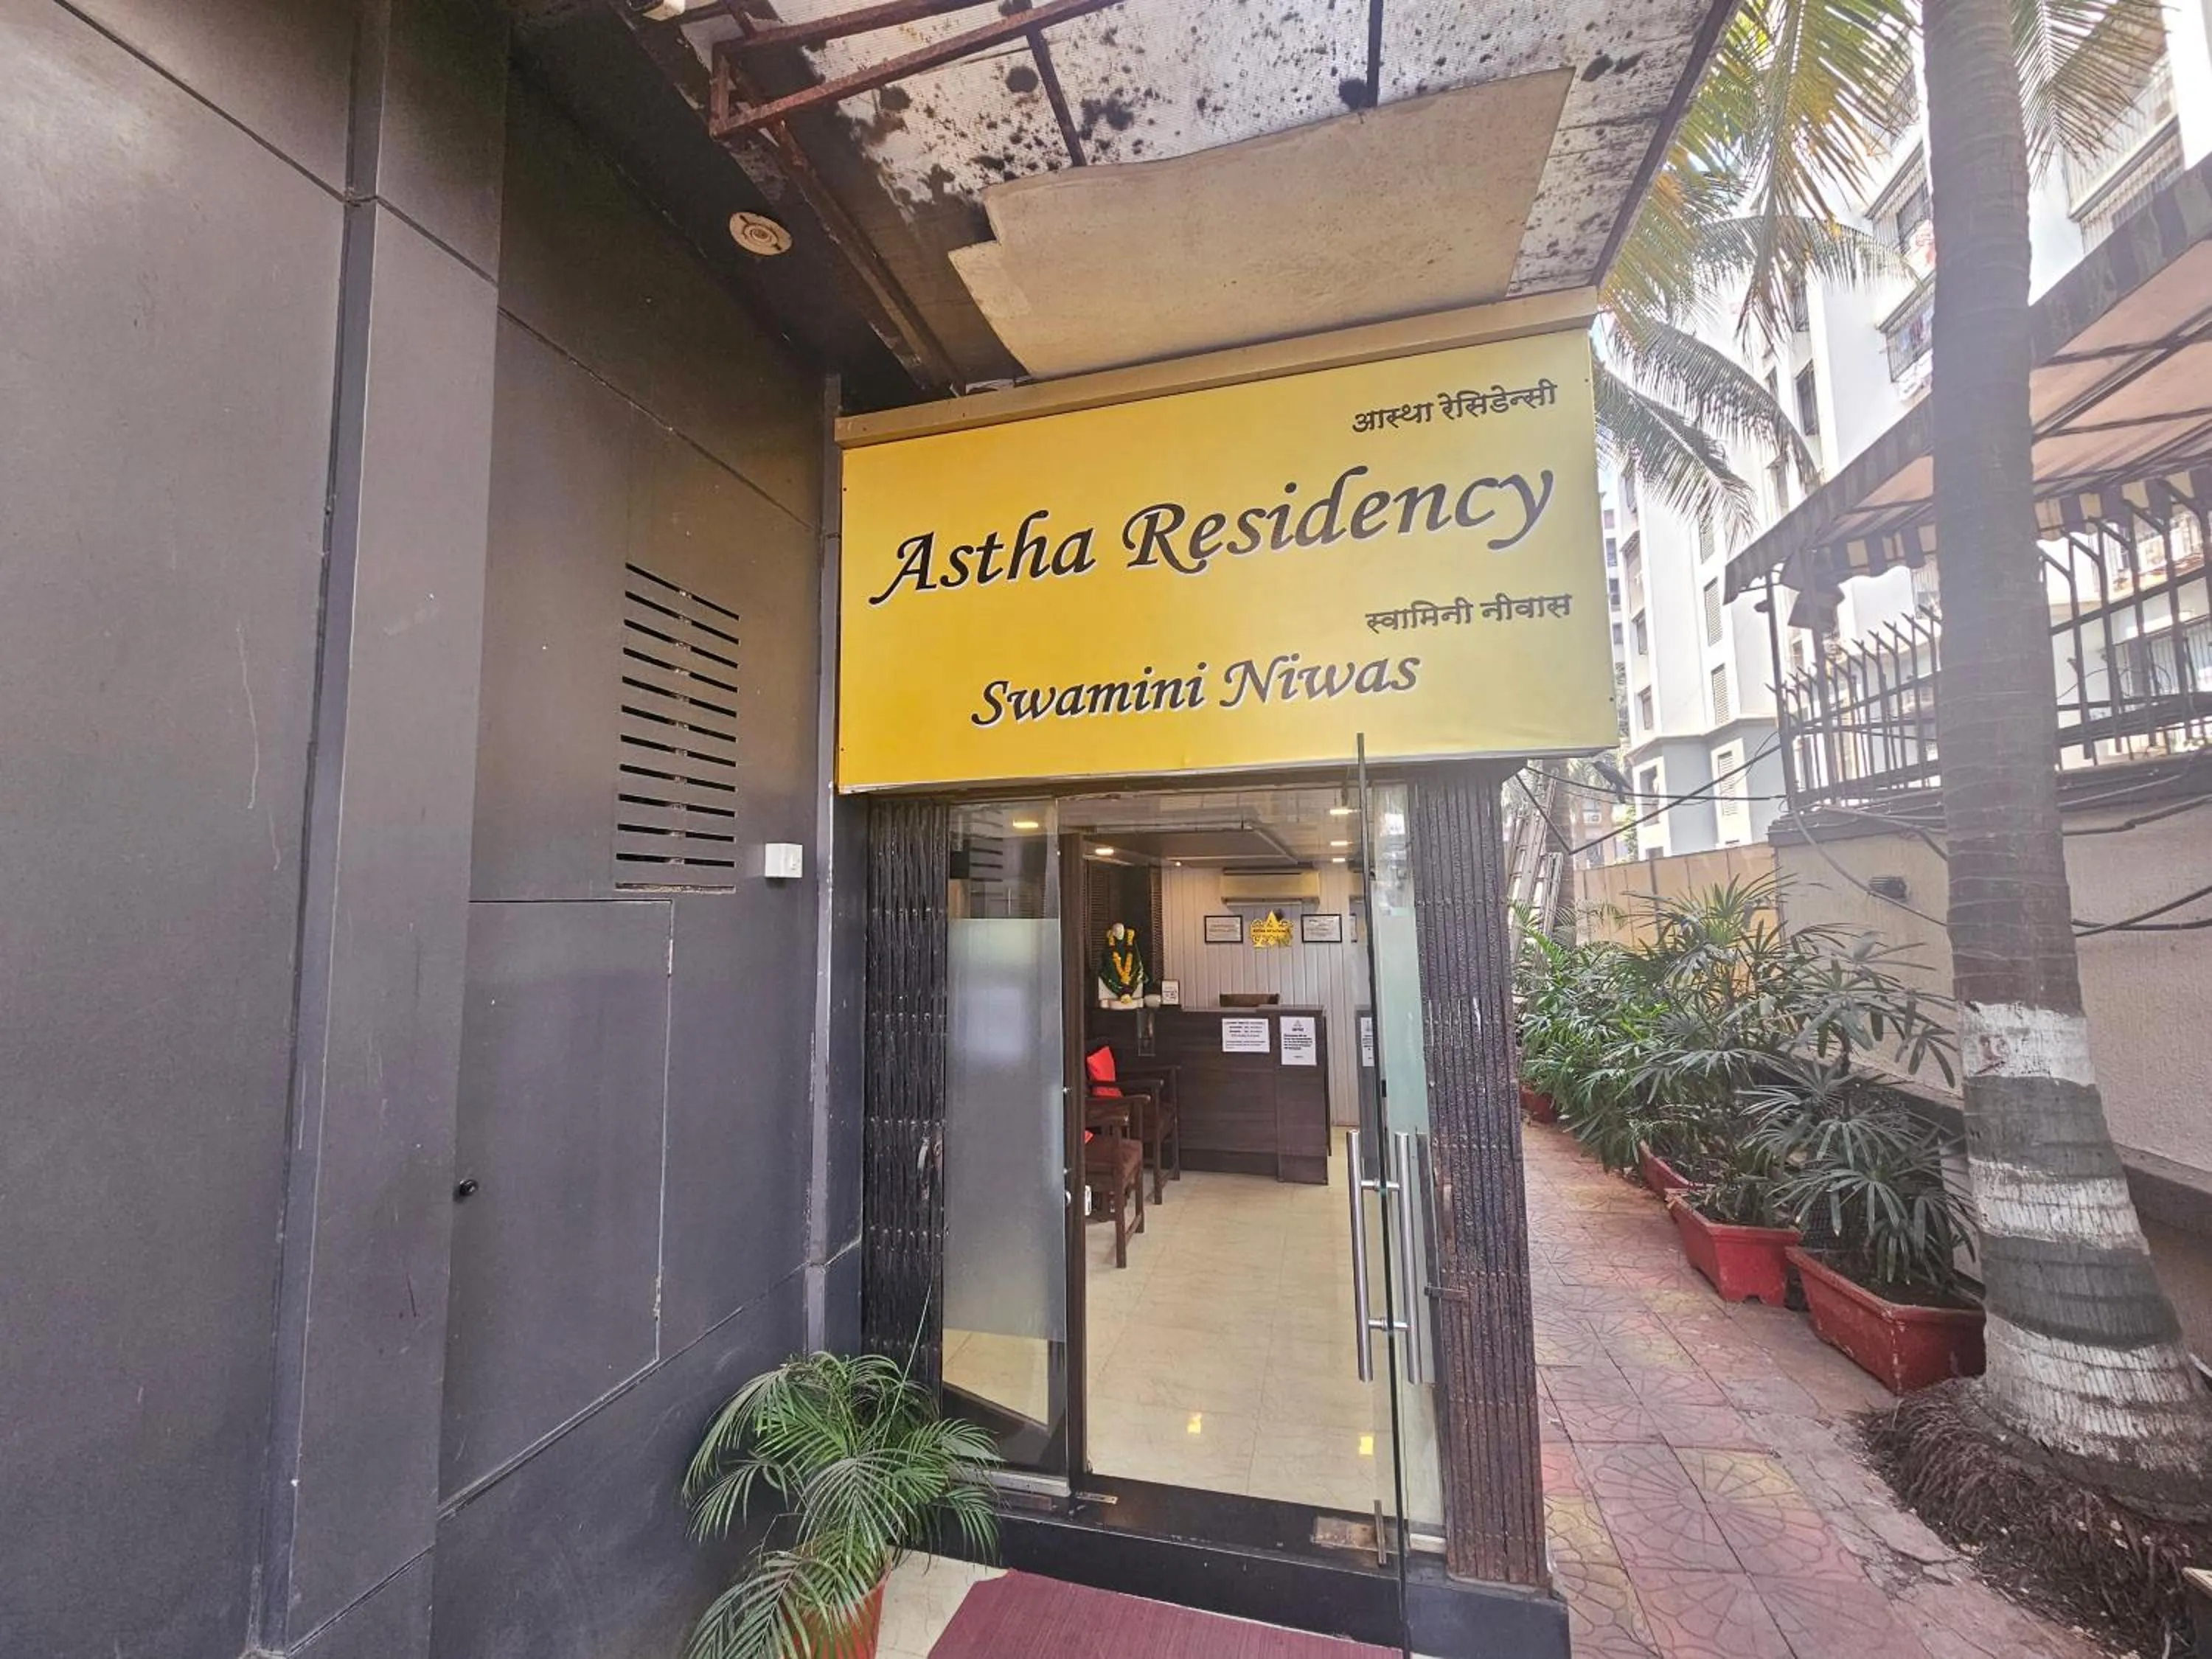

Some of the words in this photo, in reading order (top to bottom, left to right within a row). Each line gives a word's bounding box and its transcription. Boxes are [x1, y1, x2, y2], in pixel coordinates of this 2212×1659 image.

[1352, 402, 1434, 433] आस्था
[1438, 378, 1558, 420] रेसिडेन्सी
[869, 509, 1096, 605] Astha
[1121, 465, 1554, 574] Residency
[1366, 596, 1474, 634] स्वामिनी
[1479, 593, 1572, 622] नीवास
[970, 661, 1206, 726] Swamini
[1219, 653, 1422, 708] Niwas
